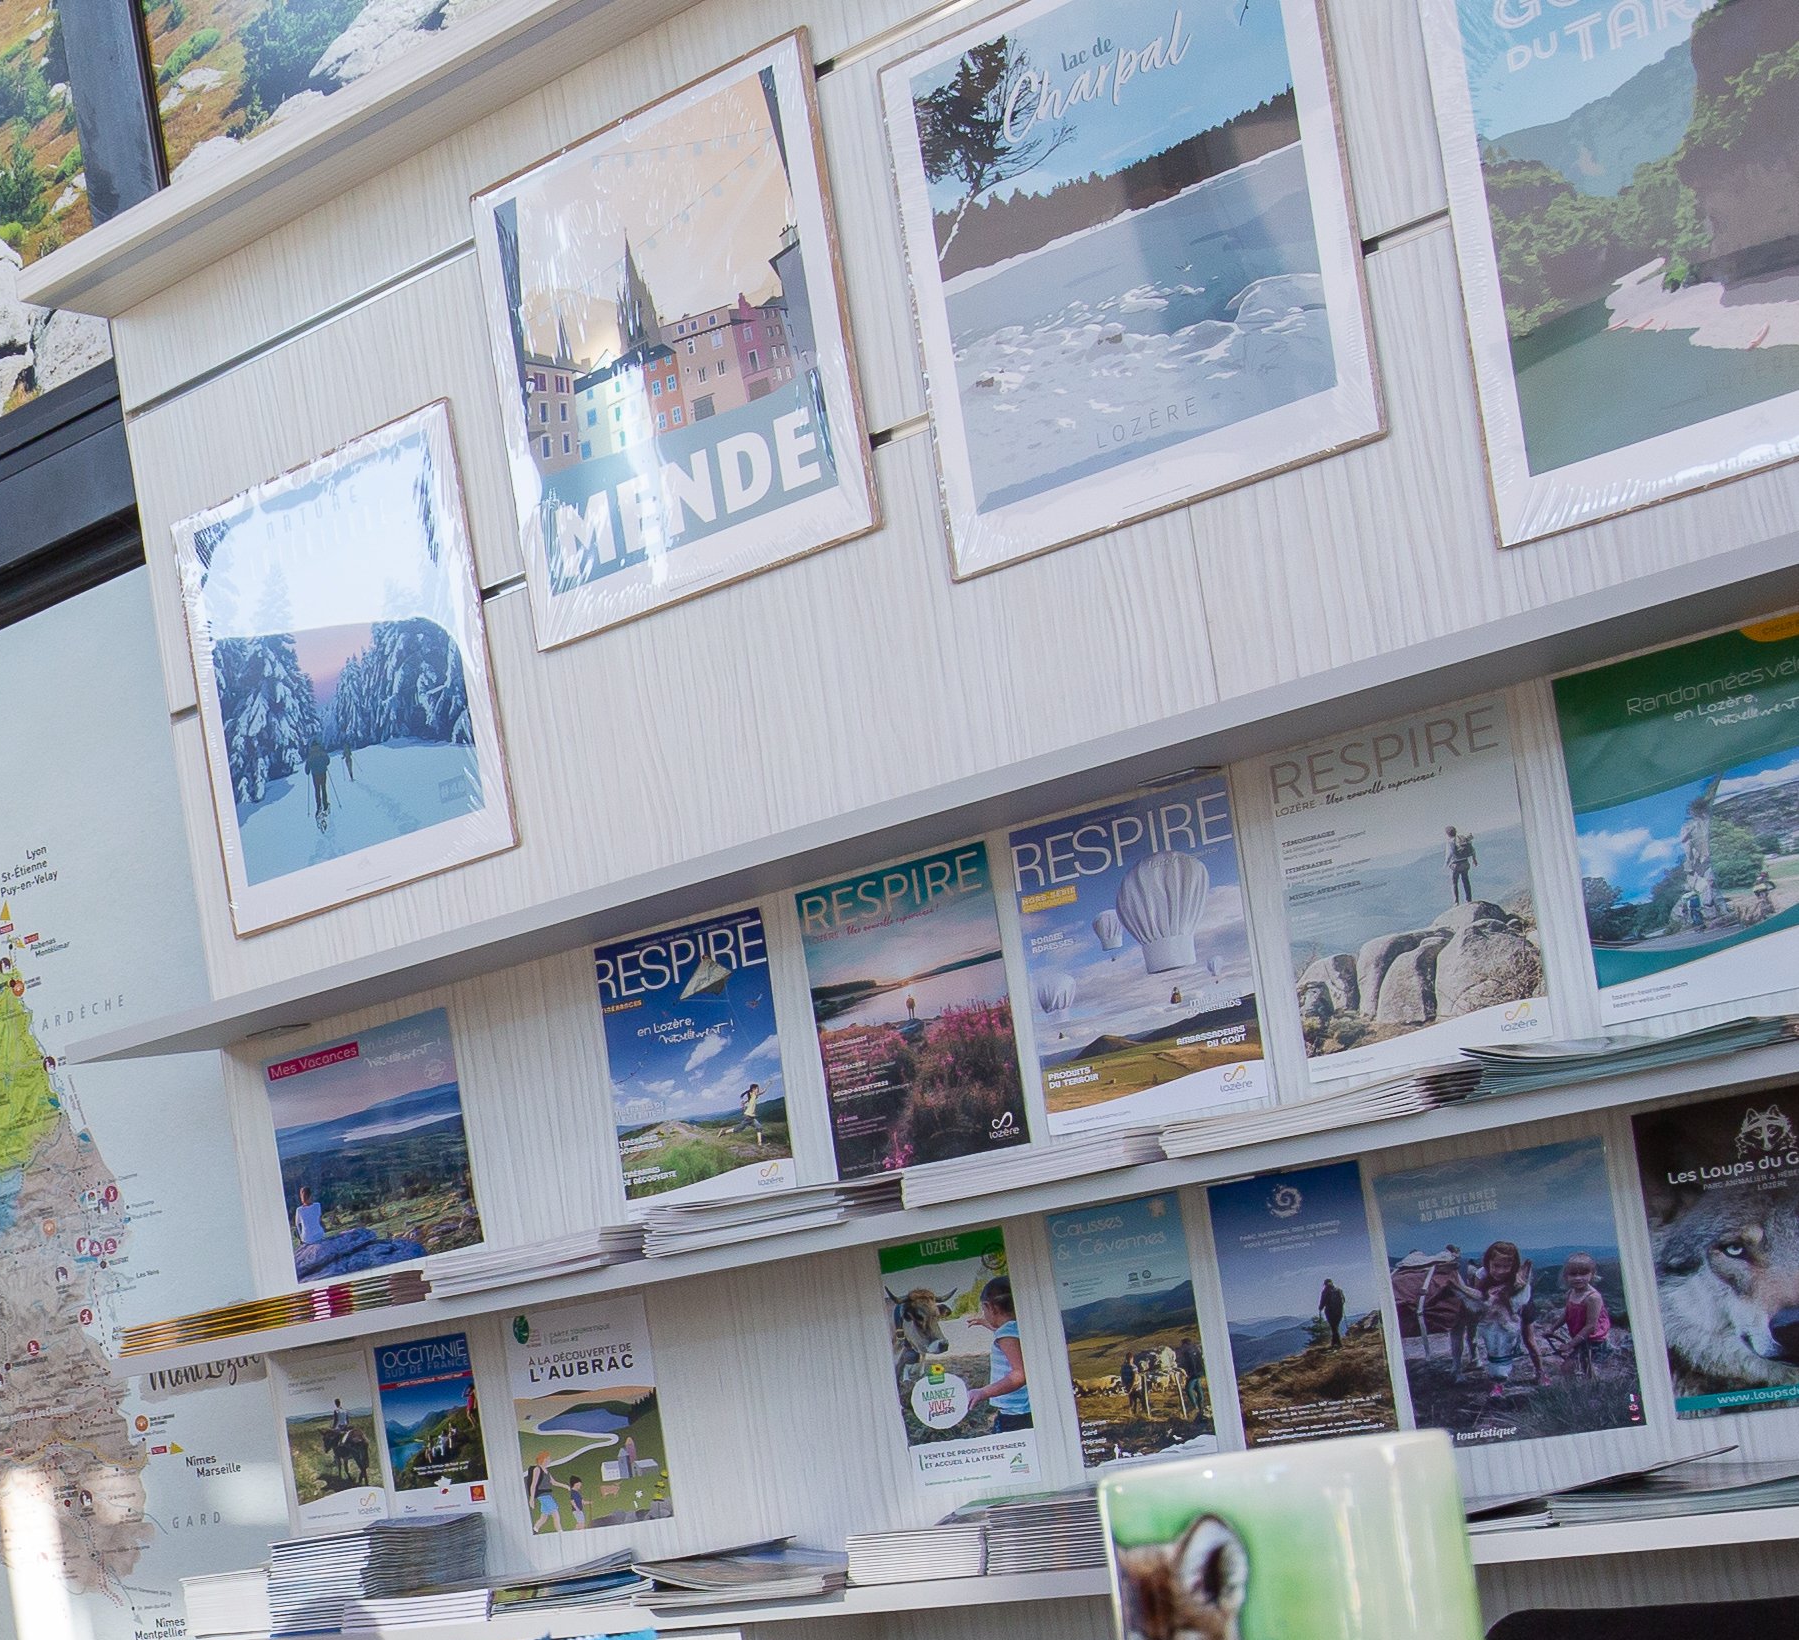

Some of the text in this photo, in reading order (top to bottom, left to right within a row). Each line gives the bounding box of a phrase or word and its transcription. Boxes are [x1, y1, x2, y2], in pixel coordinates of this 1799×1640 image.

[1061, 37, 1114, 72] lac de
[1506, 31, 1557, 72] DU
[1002, 9, 1191, 144] Charpal
[1096, 396, 1198, 448] LOZÈRE
[557, 407, 822, 578] MENDE
[1626, 666, 1765, 716] Randonnées
[1673, 694, 1759, 722] en Lozère,
[1268, 705, 1500, 804] RESPIRE
[1275, 800, 1317, 818] LOZÈRE
[1325, 793, 1343, 806] Une
[25, 845, 47, 860] Lyon
[1010, 791, 1233, 892] RESPIRE
[1, 859, 48, 882] St-Étienne
[0, 870, 59, 898] Puy-en-Velay
[801, 850, 983, 934] RESPIRE
[1288, 880, 1361, 902] MICRO-AVENTURES
[595, 920, 768, 999] RESPIRE
[41, 994, 124, 1032] ARDÈCHE
[637, 1027, 651, 1037] en
[1500, 1017, 1538, 1033] lozère
[1207, 1033, 1246, 1048] DU GOÛT
[269, 1066, 297, 1079] Mes
[298, 1046, 358, 1071] Vacances
[1047, 1066, 1092, 1081] PRODUITS
[1064, 1073, 1099, 1088] TERROIR
[1219, 1079, 1253, 1093] lozère
[988, 1125, 1020, 1140] lozère
[1668, 1170, 1697, 1185] Les
[1700, 1160, 1755, 1177] Loups
[1758, 1155, 1781, 1170] du
[1052, 1216, 1124, 1239] Causses
[1057, 1231, 1167, 1261] & Cévennes
[382, 1340, 467, 1369] OCCITANIE
[537, 1356, 551, 1366] LA
[552, 1344, 618, 1363] DÉCOUVERTE
[618, 1342, 632, 1353] DE
[385, 1356, 469, 1379] SUD DE FRANCE
[529, 1353, 634, 1383] L'AUBRAC
[921, 1387, 956, 1402] MANGEZ
[928, 1399, 952, 1412] VIVEZ
[1457, 1424, 1517, 1442] touristique
[185, 1455, 217, 1467] Nîmes
[923, 1450, 945, 1460] VENTE
[957, 1446, 991, 1455] PRODUITS
[992, 1441, 1027, 1452] FERMIERS
[934, 1459, 963, 1468] ACCUEIL
[981, 1453, 1005, 1461] FERME
[196, 1463, 241, 1478] Marseille
[172, 1511, 221, 1529] GARD
[134, 1627, 189, 1640] Montpellier
[155, 1617, 185, 1628] Nîmes
